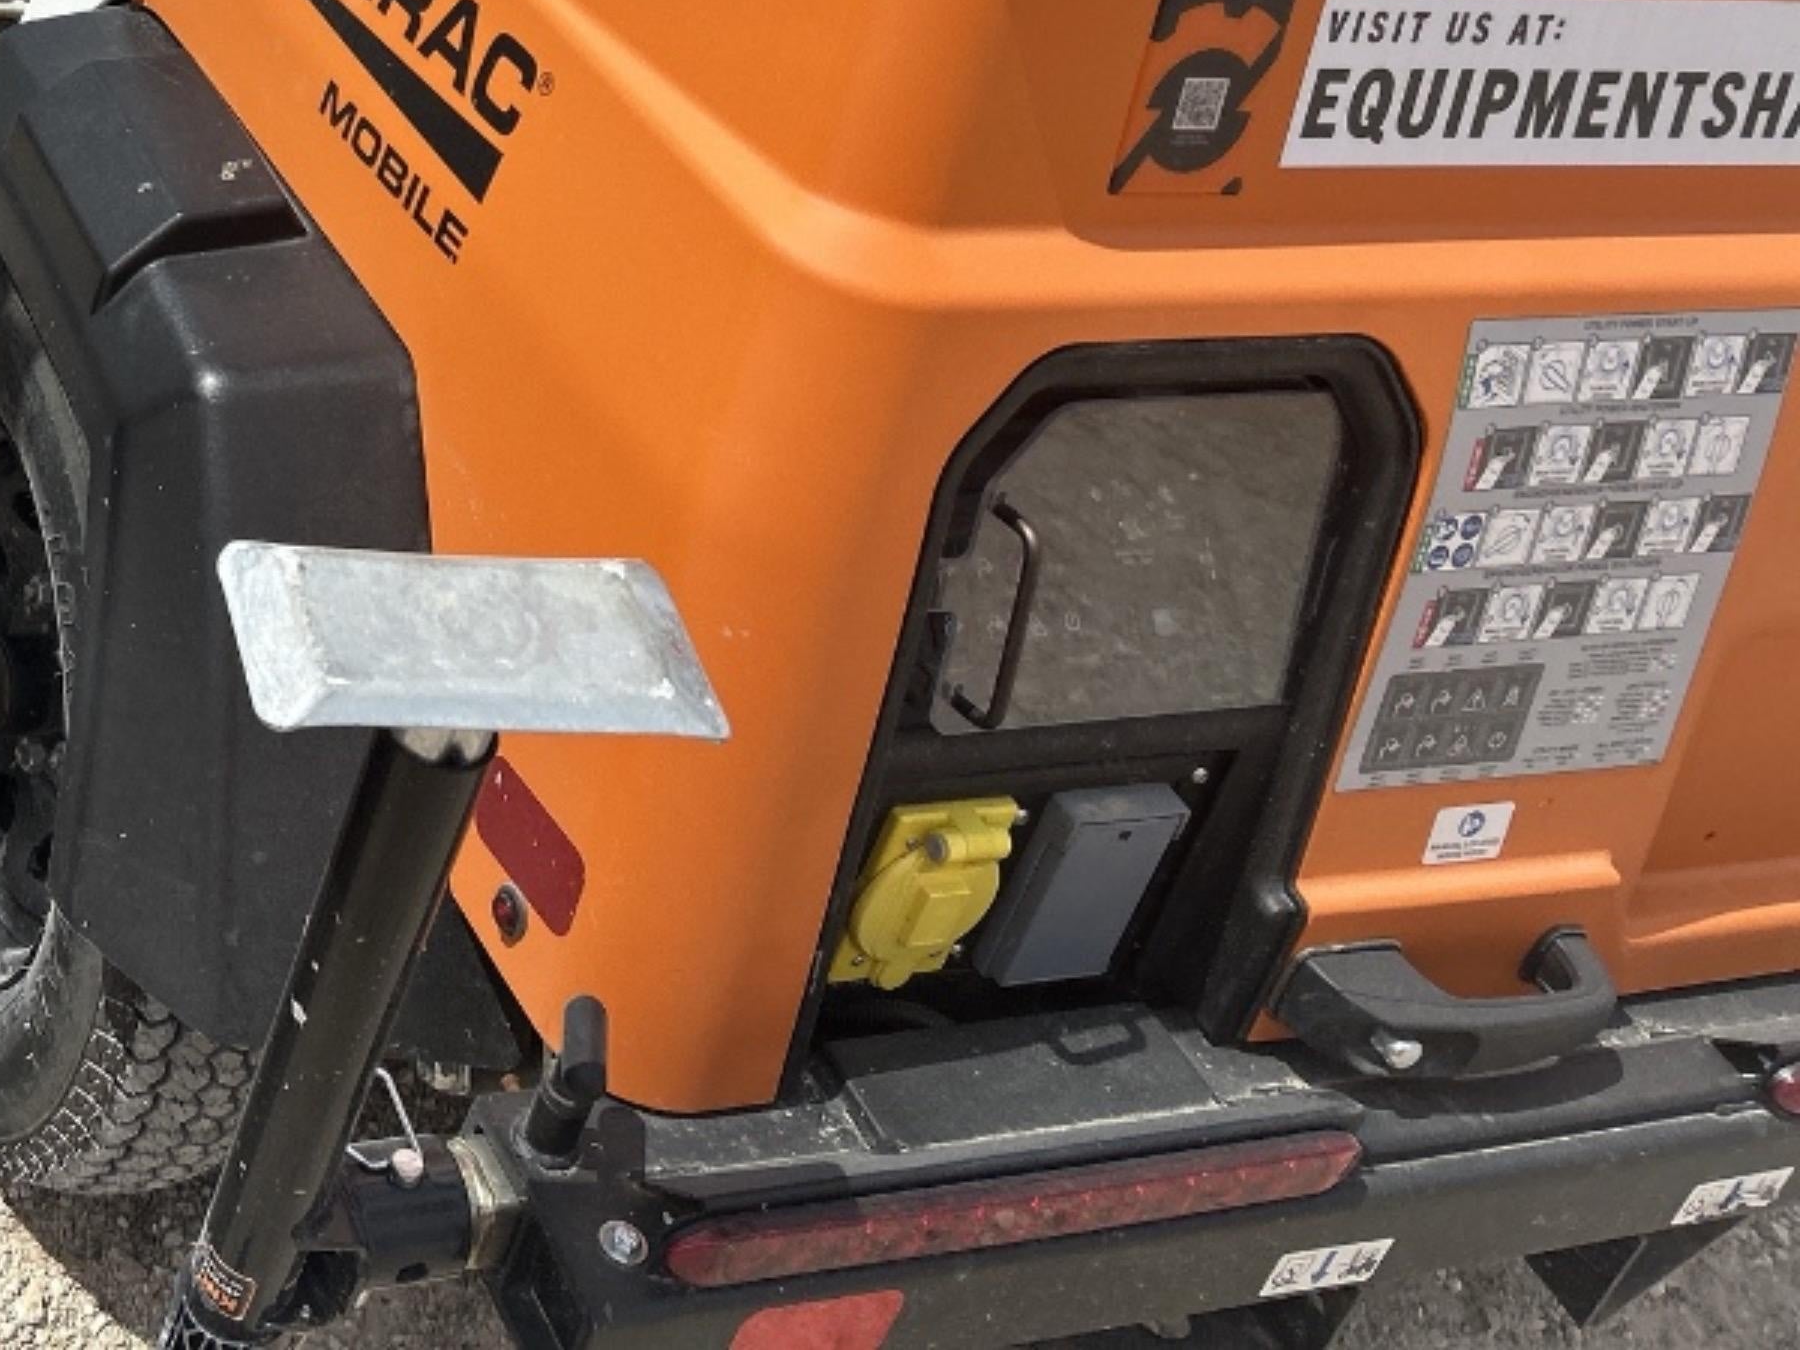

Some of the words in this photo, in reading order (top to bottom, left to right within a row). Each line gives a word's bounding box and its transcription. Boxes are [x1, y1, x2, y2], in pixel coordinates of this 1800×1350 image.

[1328, 10, 1430, 43] VISIT
[1445, 12, 1493, 44] US
[1507, 14, 1567, 46] AT:
[318, 80, 469, 264] MOBILE
